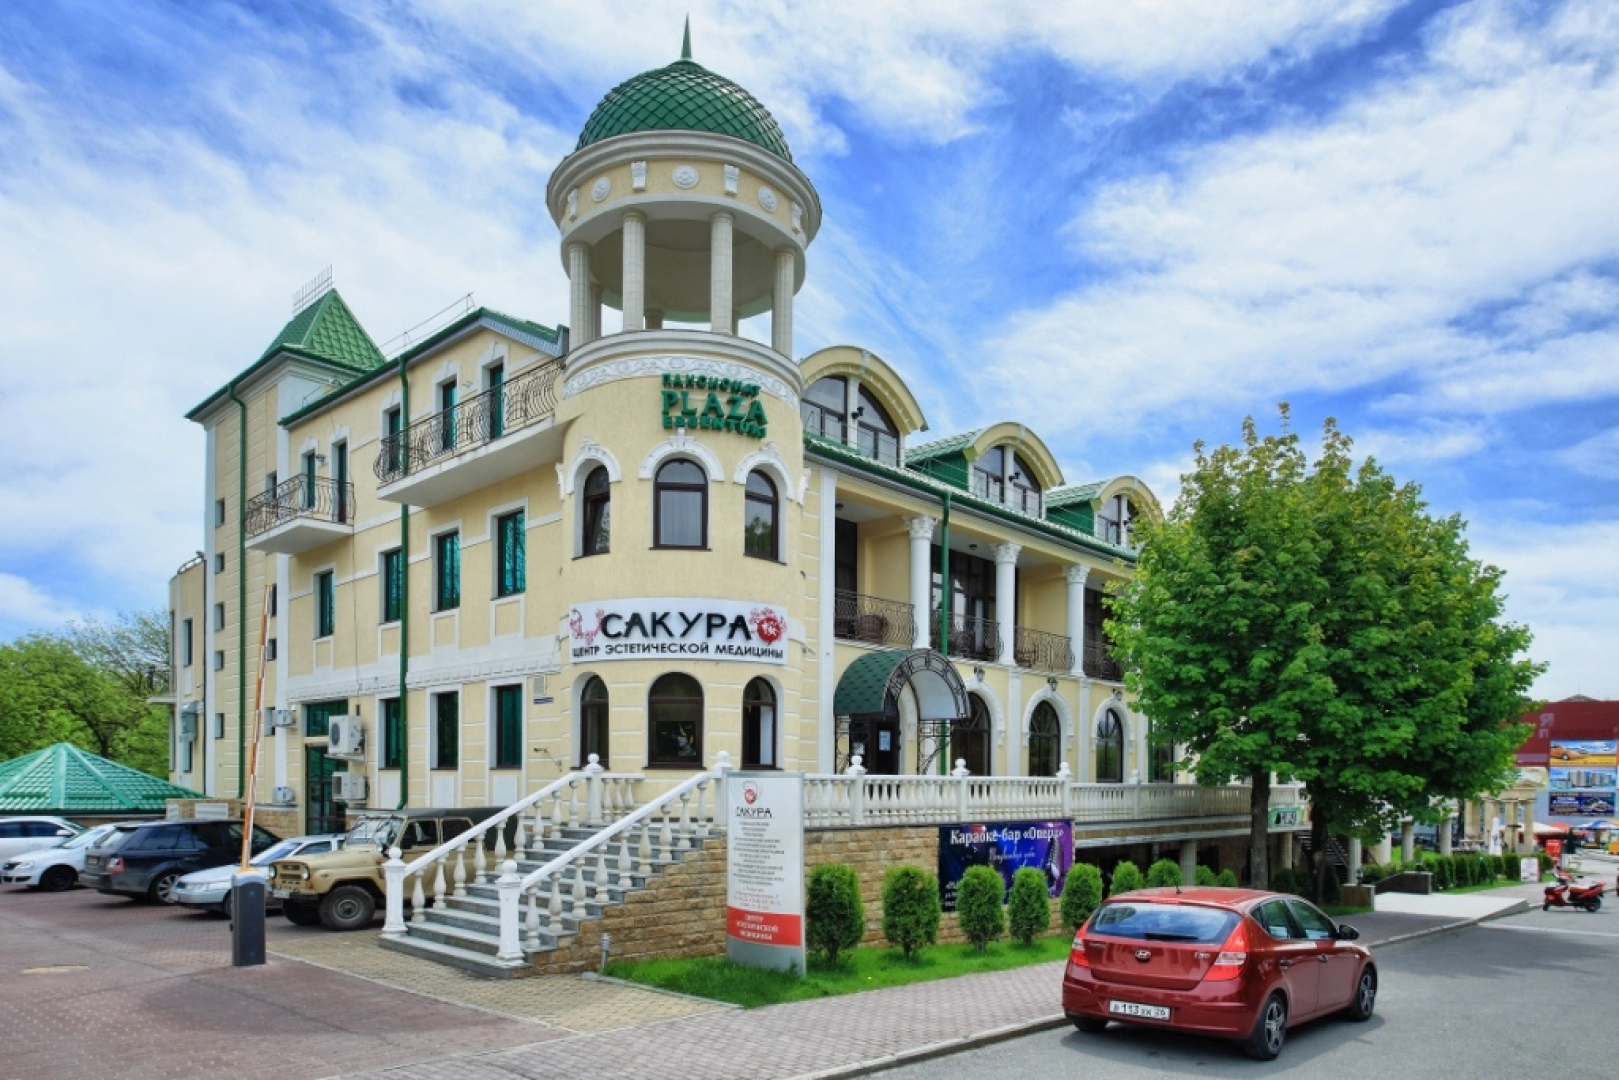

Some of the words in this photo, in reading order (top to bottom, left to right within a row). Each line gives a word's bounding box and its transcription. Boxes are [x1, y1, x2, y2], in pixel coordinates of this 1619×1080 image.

[661, 390, 768, 425] PLAZA
[601, 611, 752, 640] САКУРА
[572, 647, 600, 657] ЦЕНТР
[605, 642, 709, 655] ЭСТЕТИЧЕСКОЙ
[715, 646, 784, 658] МЕДИЦИНЫ
[950, 828, 1021, 847] Караоке-бар
